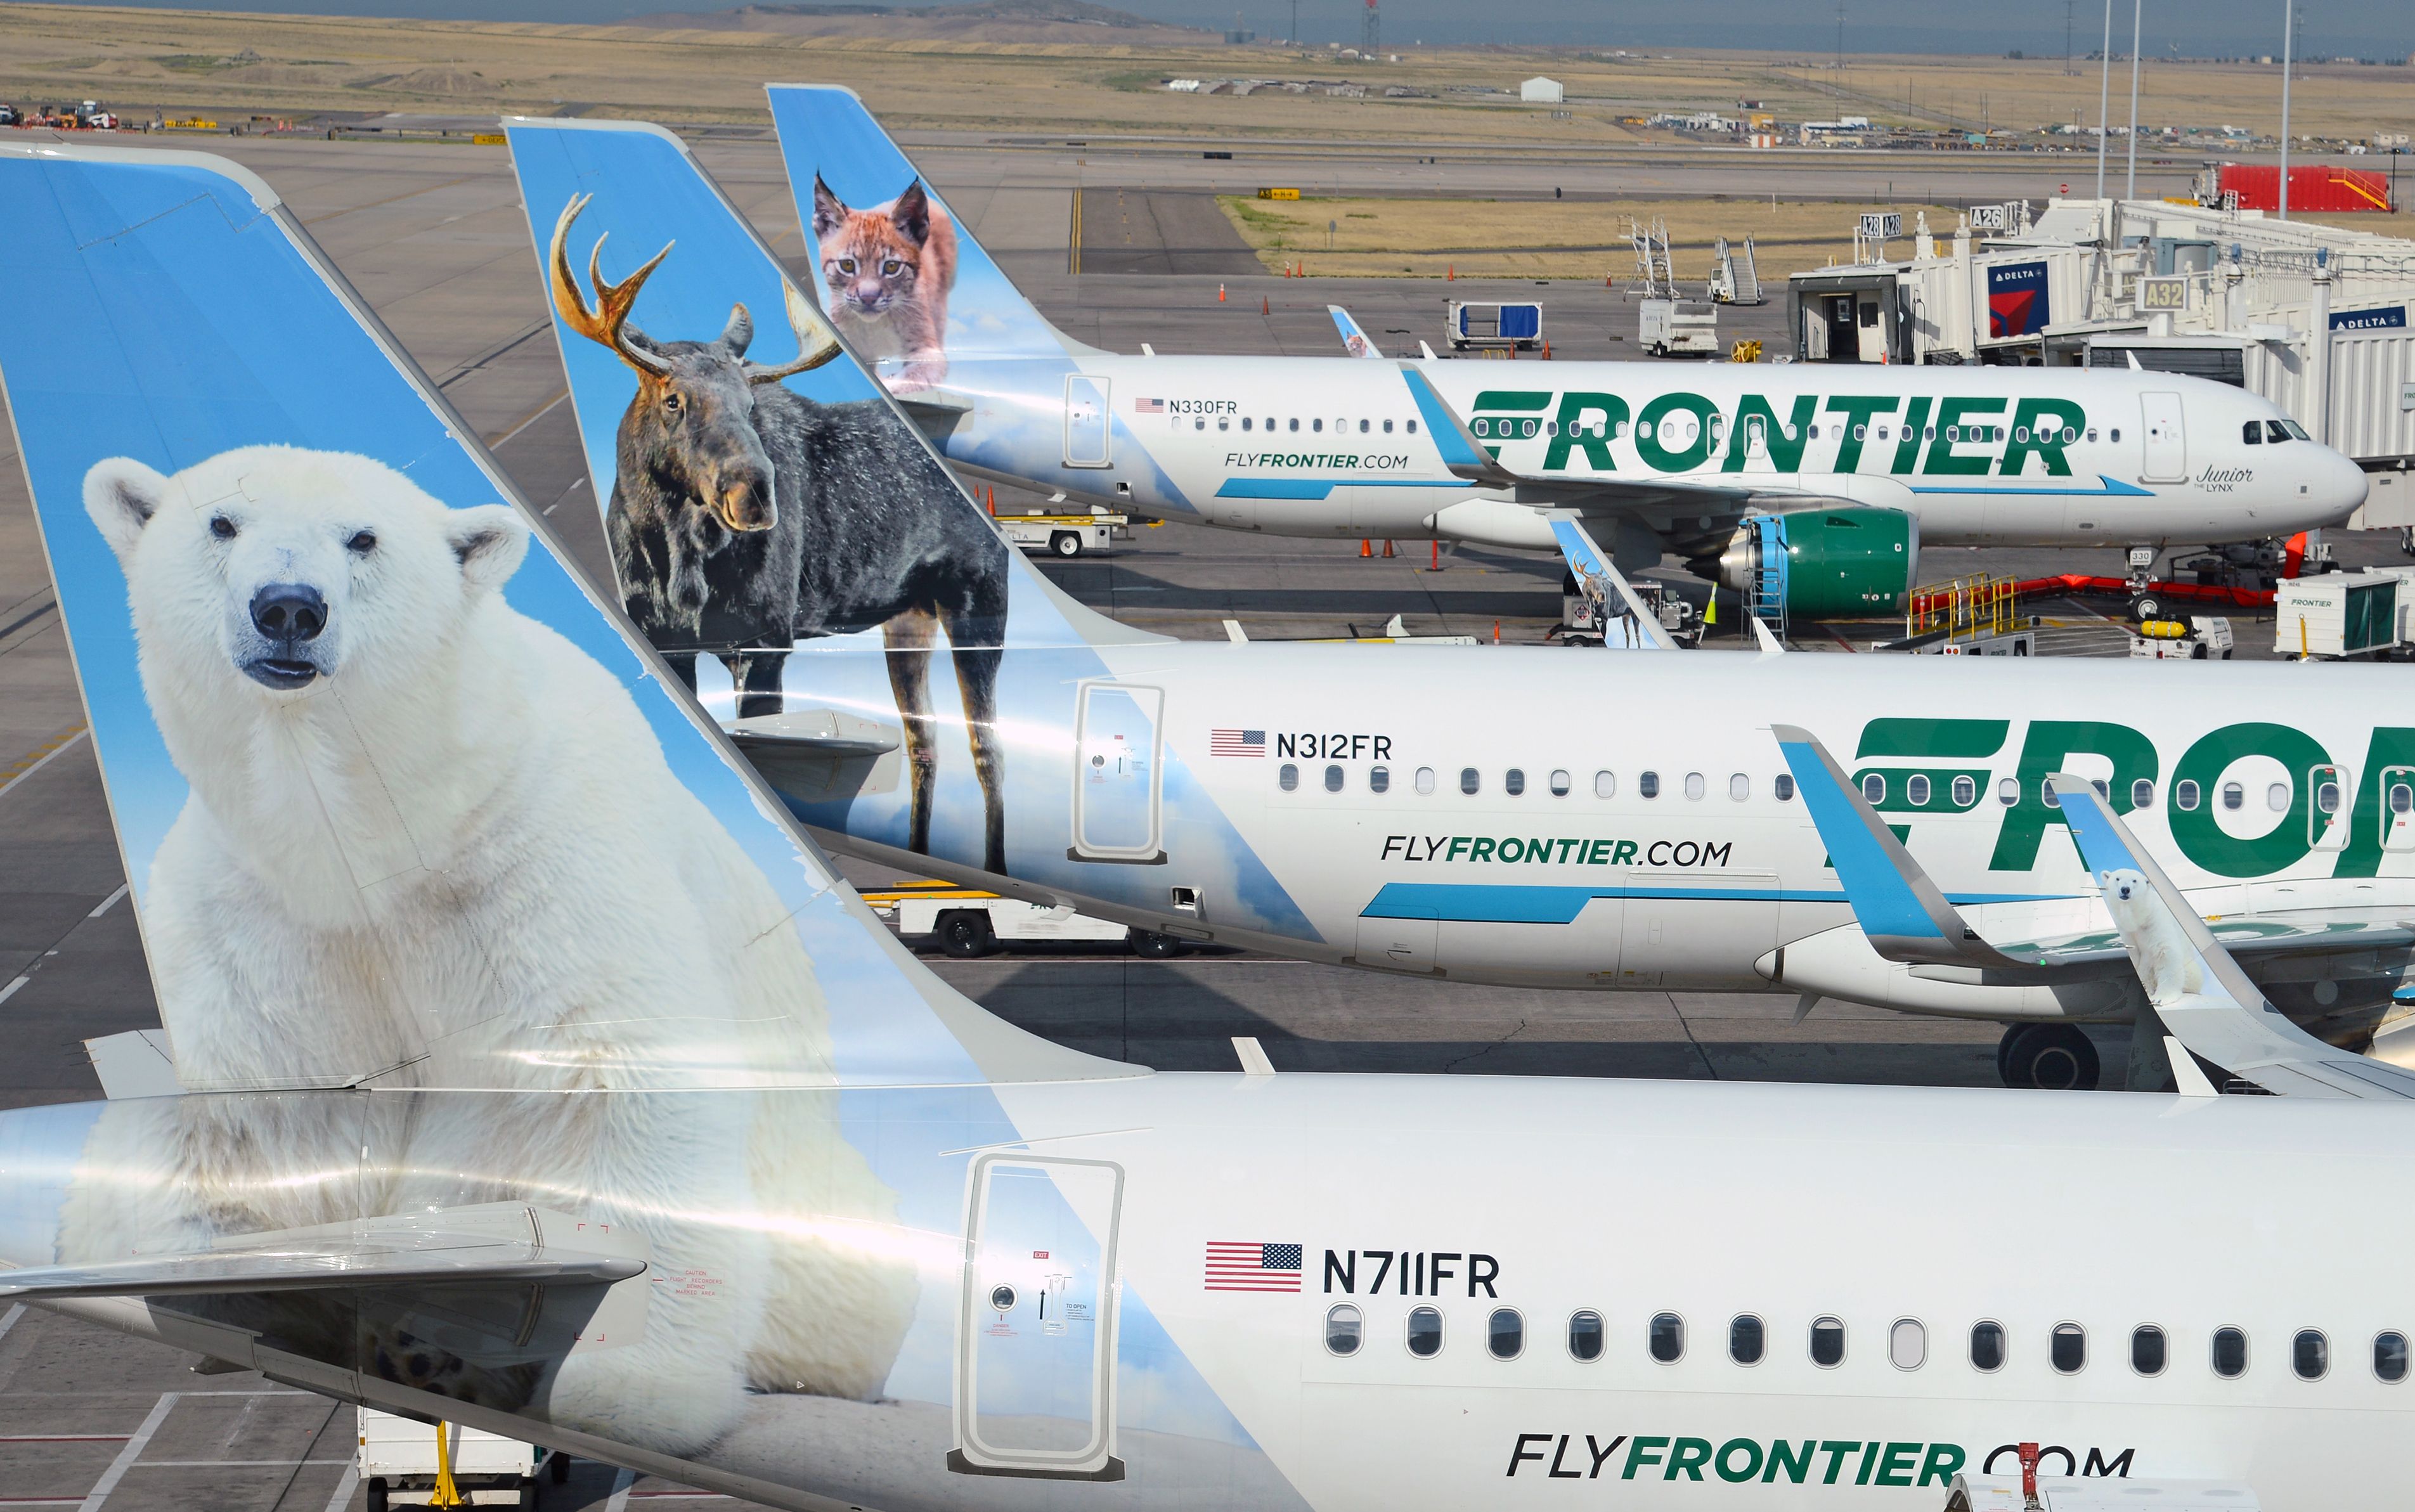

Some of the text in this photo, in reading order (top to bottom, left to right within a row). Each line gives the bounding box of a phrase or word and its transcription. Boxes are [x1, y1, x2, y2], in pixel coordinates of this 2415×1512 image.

[1863, 216, 1879, 236] A28
[1884, 216, 1900, 235] A28
[1972, 209, 2002, 228] A26
[2005, 270, 2034, 280] DELTA
[2146, 283, 2182, 306] A32
[2348, 318, 2386, 329] DELTA
[1170, 400, 1236, 413] N330FR
[1468, 391, 2086, 476] FRONTIER
[1225, 453, 1408, 469] FLYFRONTIER.COM
[2196, 464, 2253, 482] Junior
[2206, 484, 2233, 492] LYNX
[2291, 599, 2332, 607] FRONTIER
[1278, 733, 1392, 760] N312FR
[1380, 836, 1733, 867] FLYFRONTIER.COM
[1324, 1250, 1499, 1298] N711FR
[1506, 1433, 2135, 1487] FLYFRONTIERCOM
